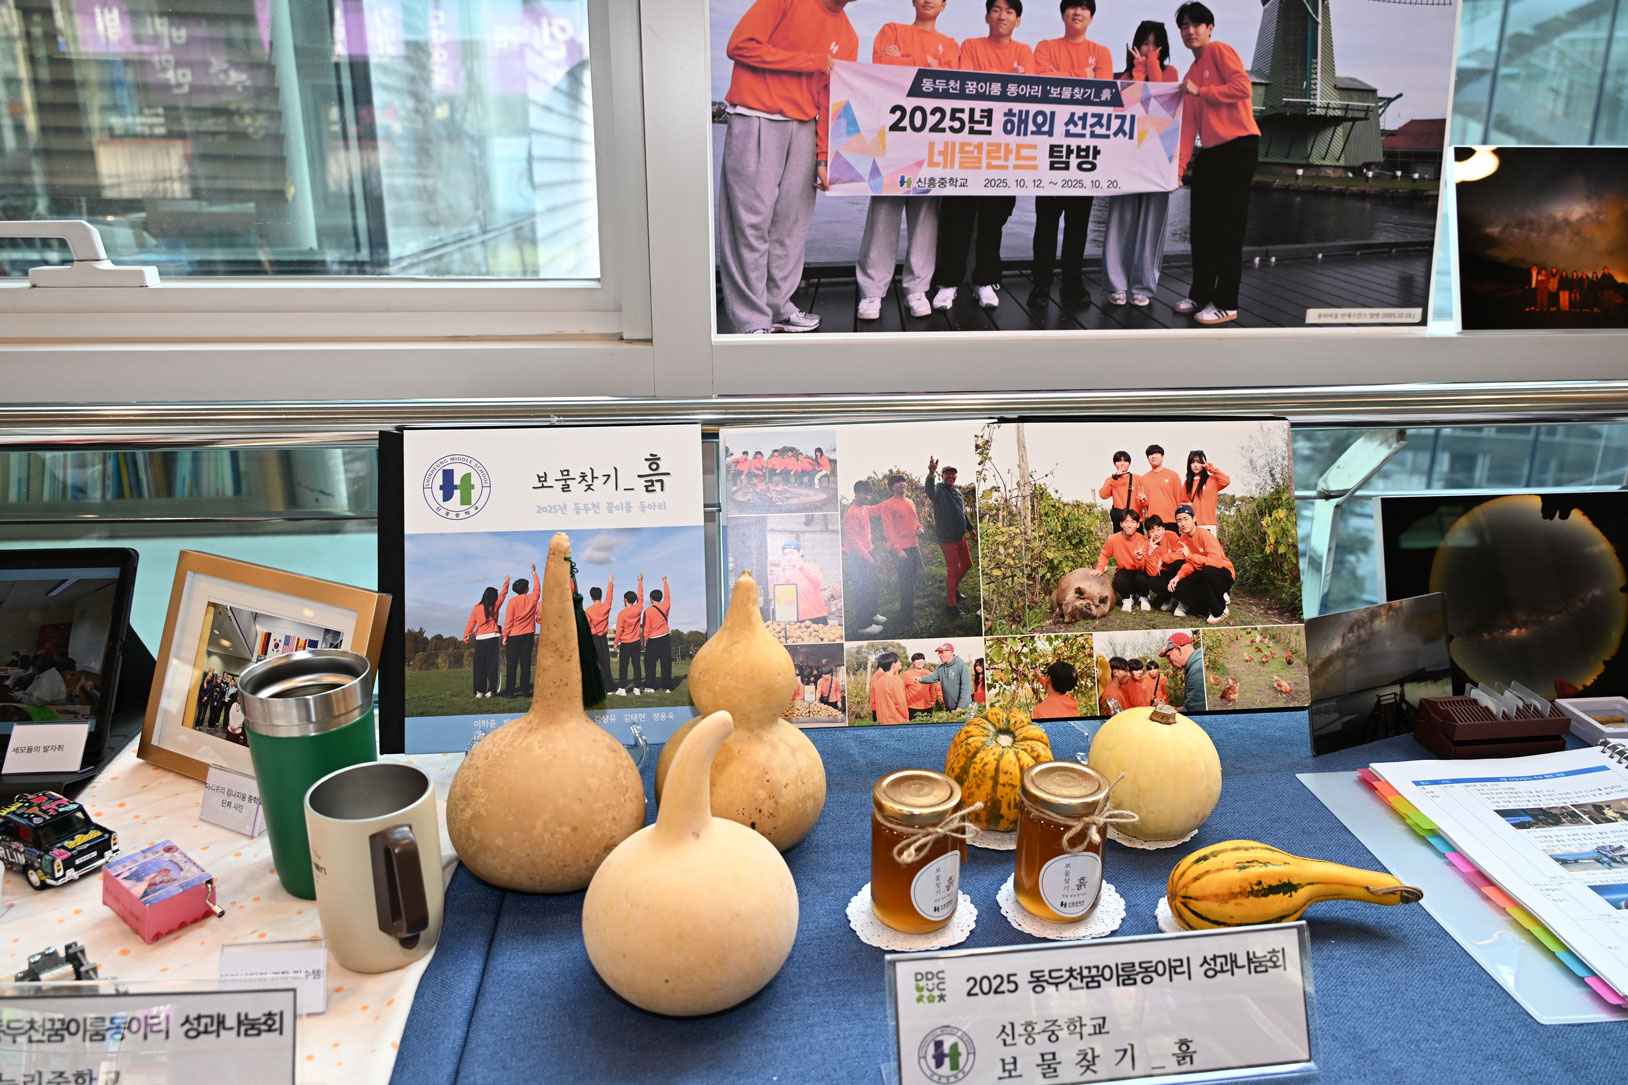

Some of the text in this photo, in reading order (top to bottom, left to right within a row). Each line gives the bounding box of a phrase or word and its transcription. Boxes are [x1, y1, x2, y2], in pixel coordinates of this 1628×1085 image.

[921, 78, 960, 93] 동두천
[965, 80, 1002, 95] 꿈이룸
[1006, 81, 1042, 97] 동아리
[888, 104, 1136, 140] 2025년 해외 선진지
[927, 141, 1101, 173] 네덜란드 탐방
[916, 177, 968, 189] 신흥중학교
[983, 178, 1010, 189] 2025.
[1015, 178, 1031, 189] 10.
[1033, 178, 1045, 189] 12.
[1060, 179, 1087, 190] 2025.
[1090, 179, 1105, 190] 10.
[1107, 179, 1121, 190] 20.
[450, 456, 473, 464] MIDDLE
[474, 463, 489, 485] SCHOOL
[536, 501, 667, 515] 2025년 동두천 꿈이룸 동아리
[42, 744, 65, 753] 발자취
[227, 788, 247, 802] 김나지움
[221, 800, 244, 813] 단체 사진
[966, 948, 1287, 997] 2025 동두천꿈이룸동아리 성과나눔회
[180, 1010, 284, 1040] 성과나눔회
[995, 1015, 1109, 1048] 신흥중학교
